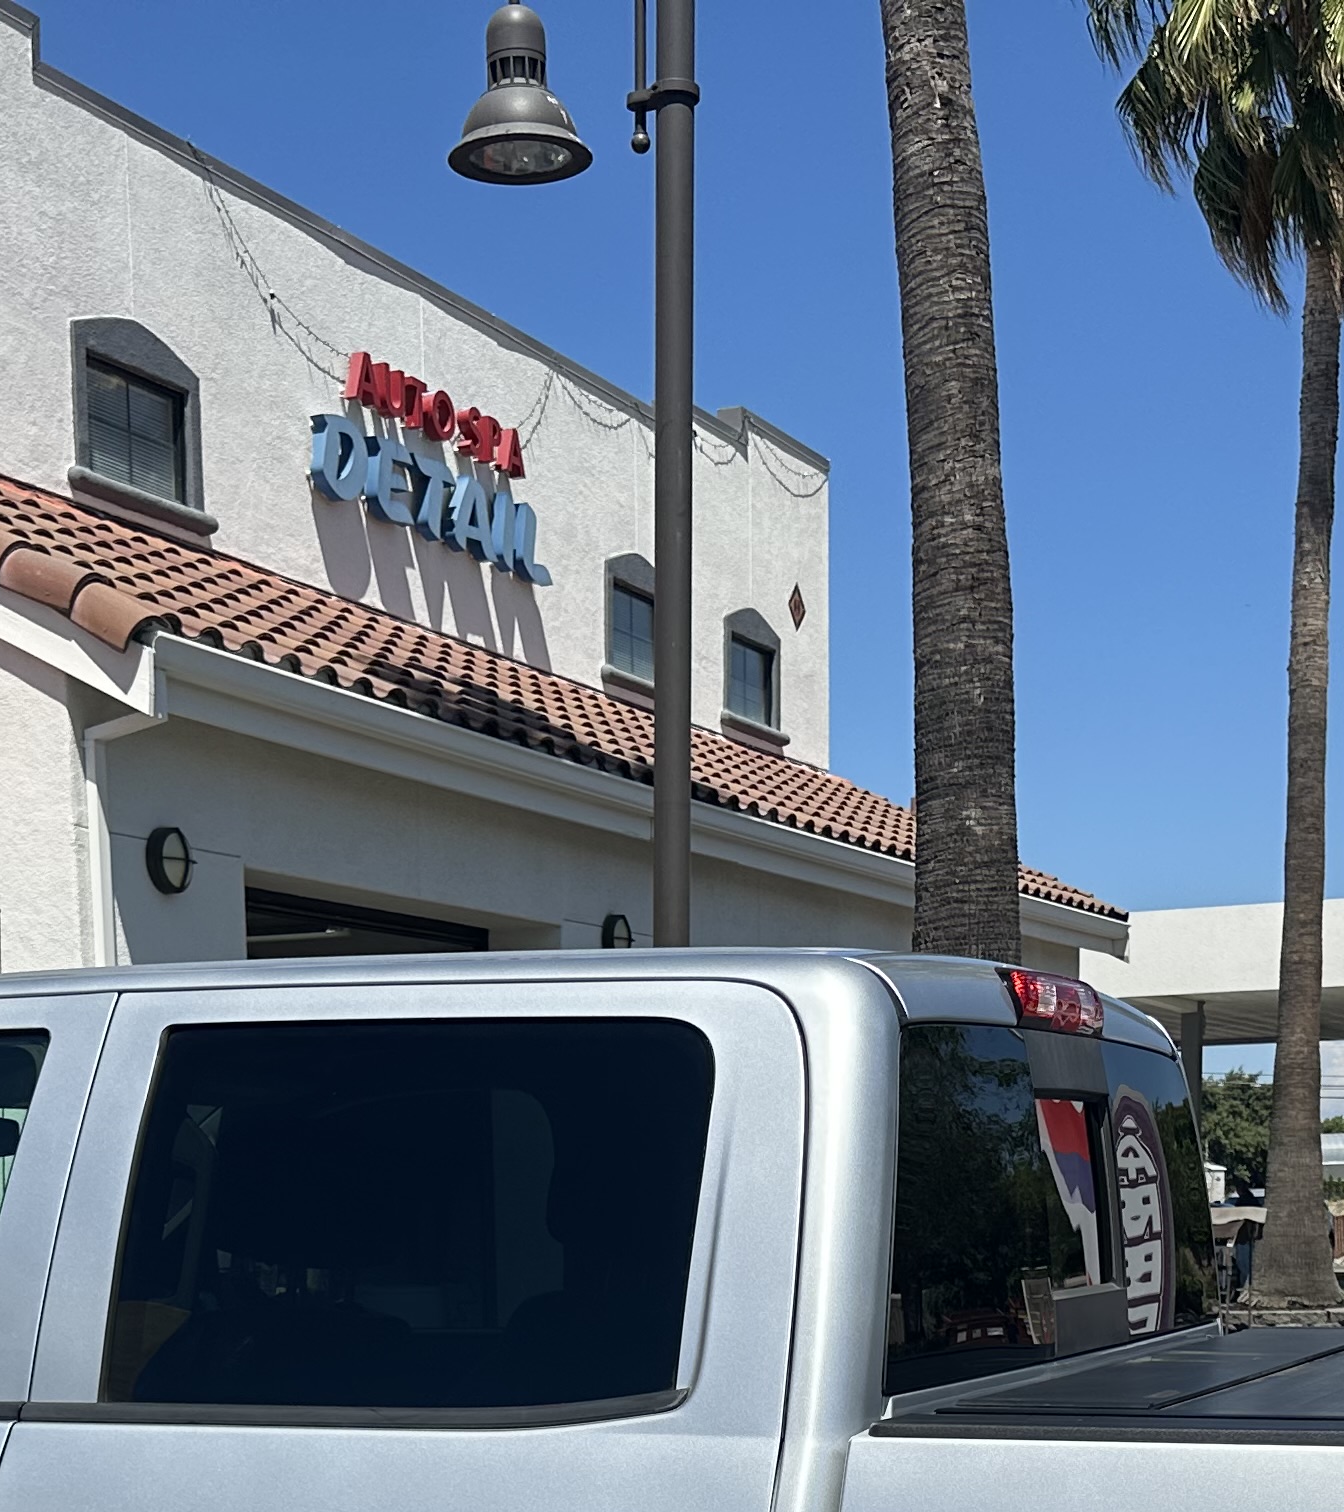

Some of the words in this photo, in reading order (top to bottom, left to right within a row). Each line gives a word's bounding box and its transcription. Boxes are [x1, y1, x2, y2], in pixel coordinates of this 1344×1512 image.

[344, 352, 456, 441] AUTO
[456, 406, 526, 480] SPA
[309, 413, 553, 587] DETAIL
